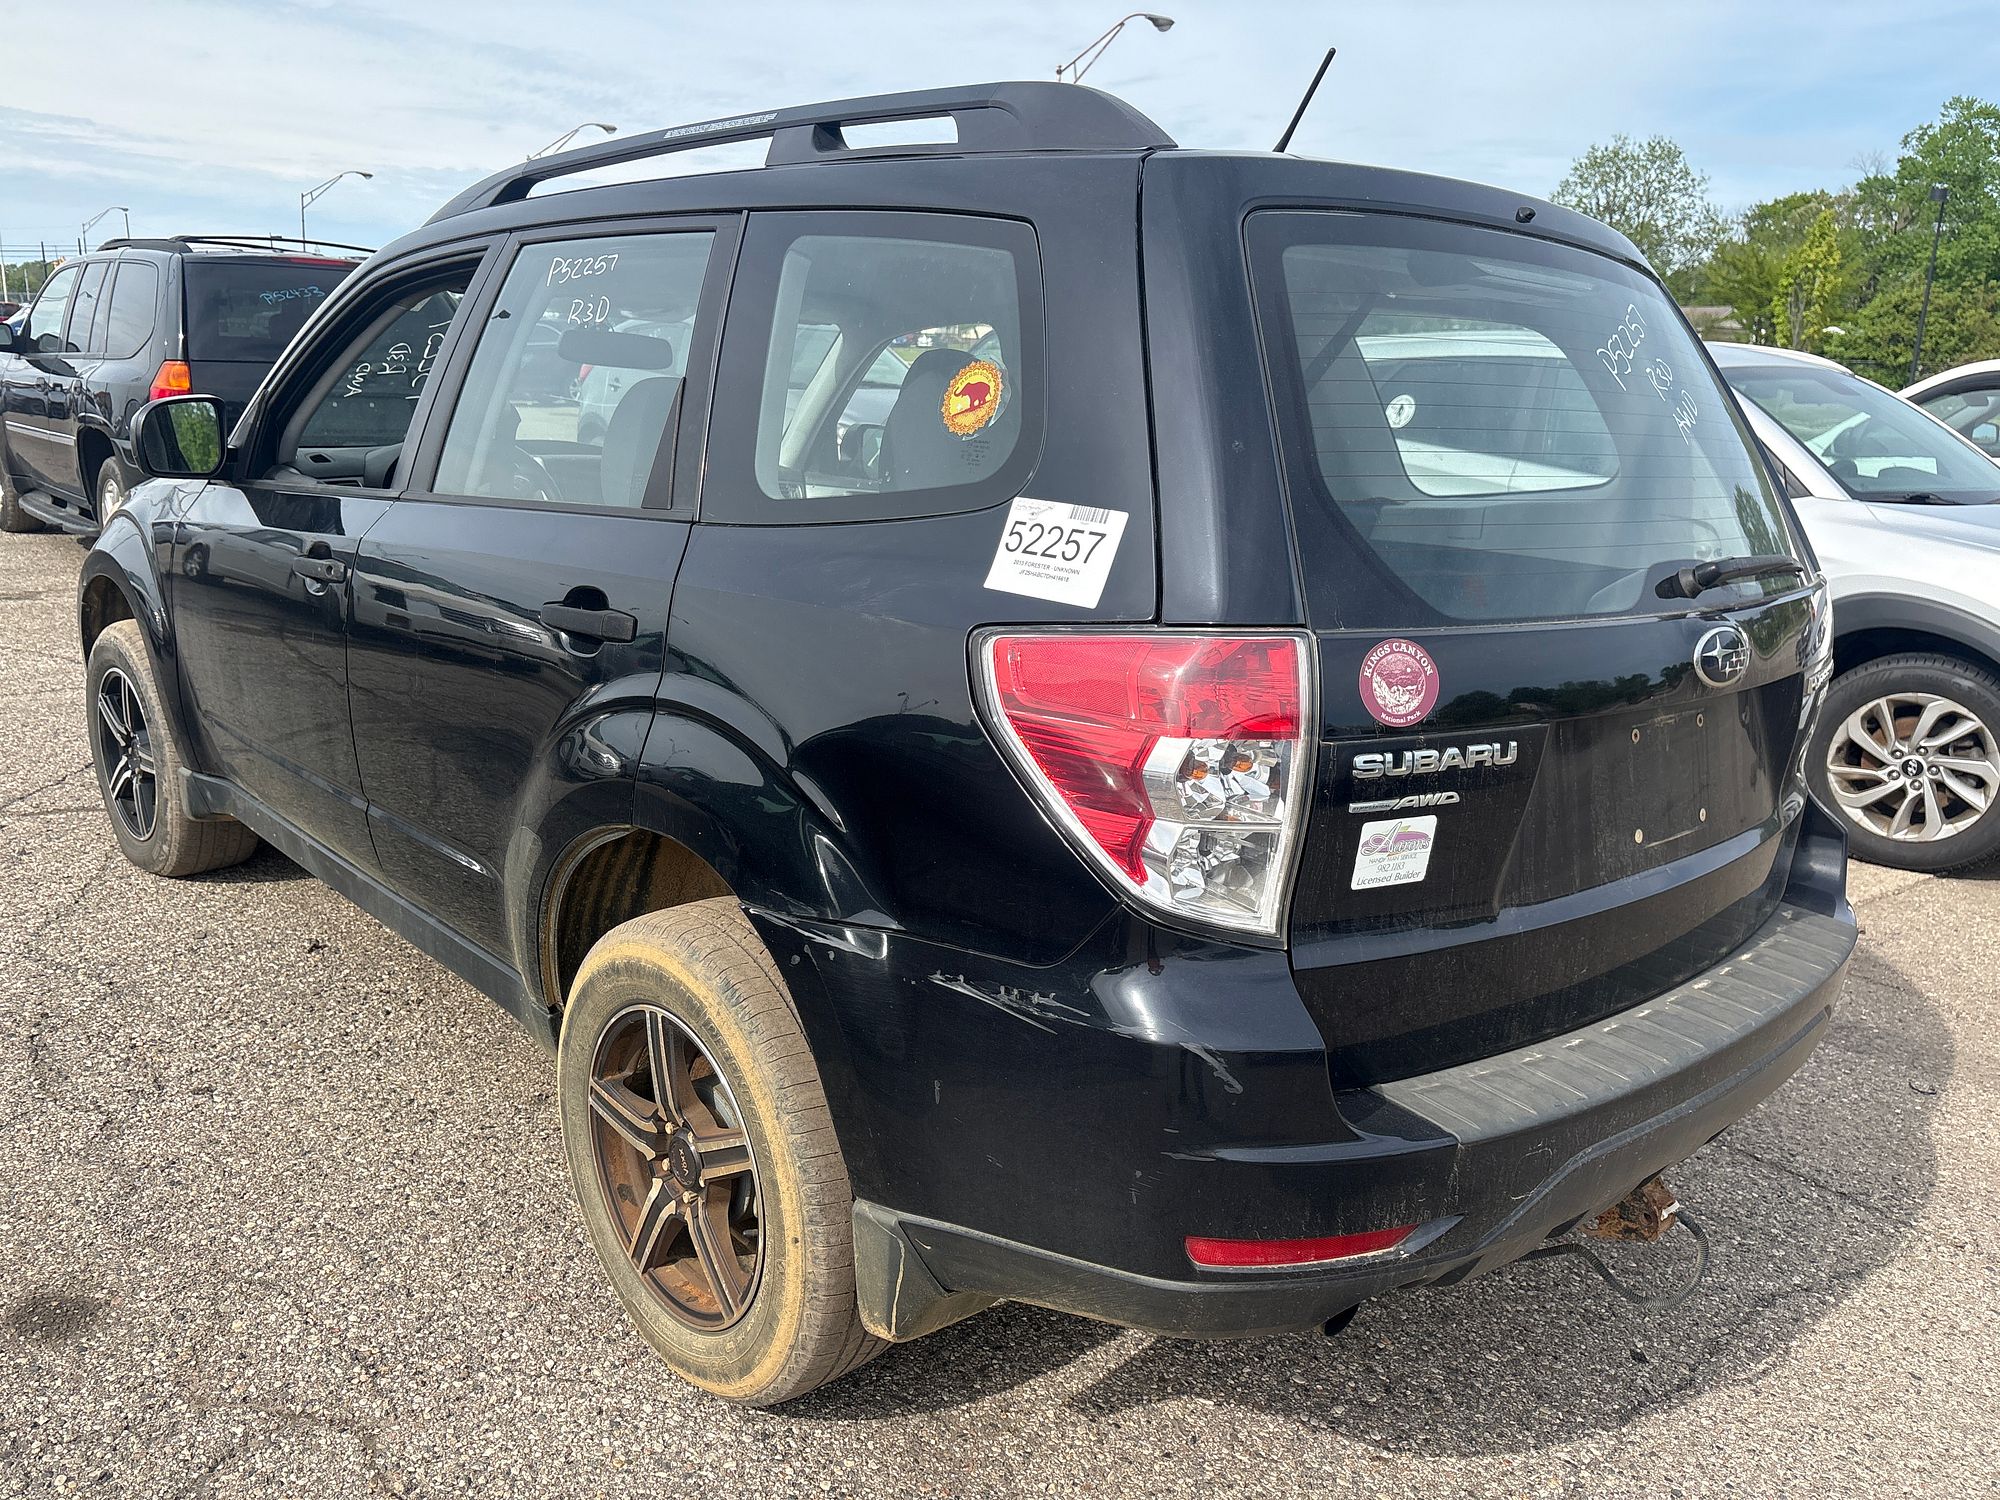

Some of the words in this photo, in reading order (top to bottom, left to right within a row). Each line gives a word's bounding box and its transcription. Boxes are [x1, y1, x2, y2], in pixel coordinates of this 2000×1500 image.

[547, 254, 619, 287] P52257
[1596, 303, 1648, 392] P52257
[1005, 520, 1107, 564] 52257
[1025, 560, 1051, 571] FORESTER
[1053, 565, 1081, 576] UNKNOWN
[1363, 644, 1391, 678] KINGS
[1392, 642, 1434, 676] CANYON
[1380, 712, 1406, 723] National
[1406, 710, 1421, 722] Park
[1352, 741, 1518, 779] SUBARU
[1391, 791, 1460, 811] AWD
[1356, 873, 1393, 886] Licensed
[1394, 870, 1421, 881] Builder
[678, 1148, 689, 1177] VOXX
